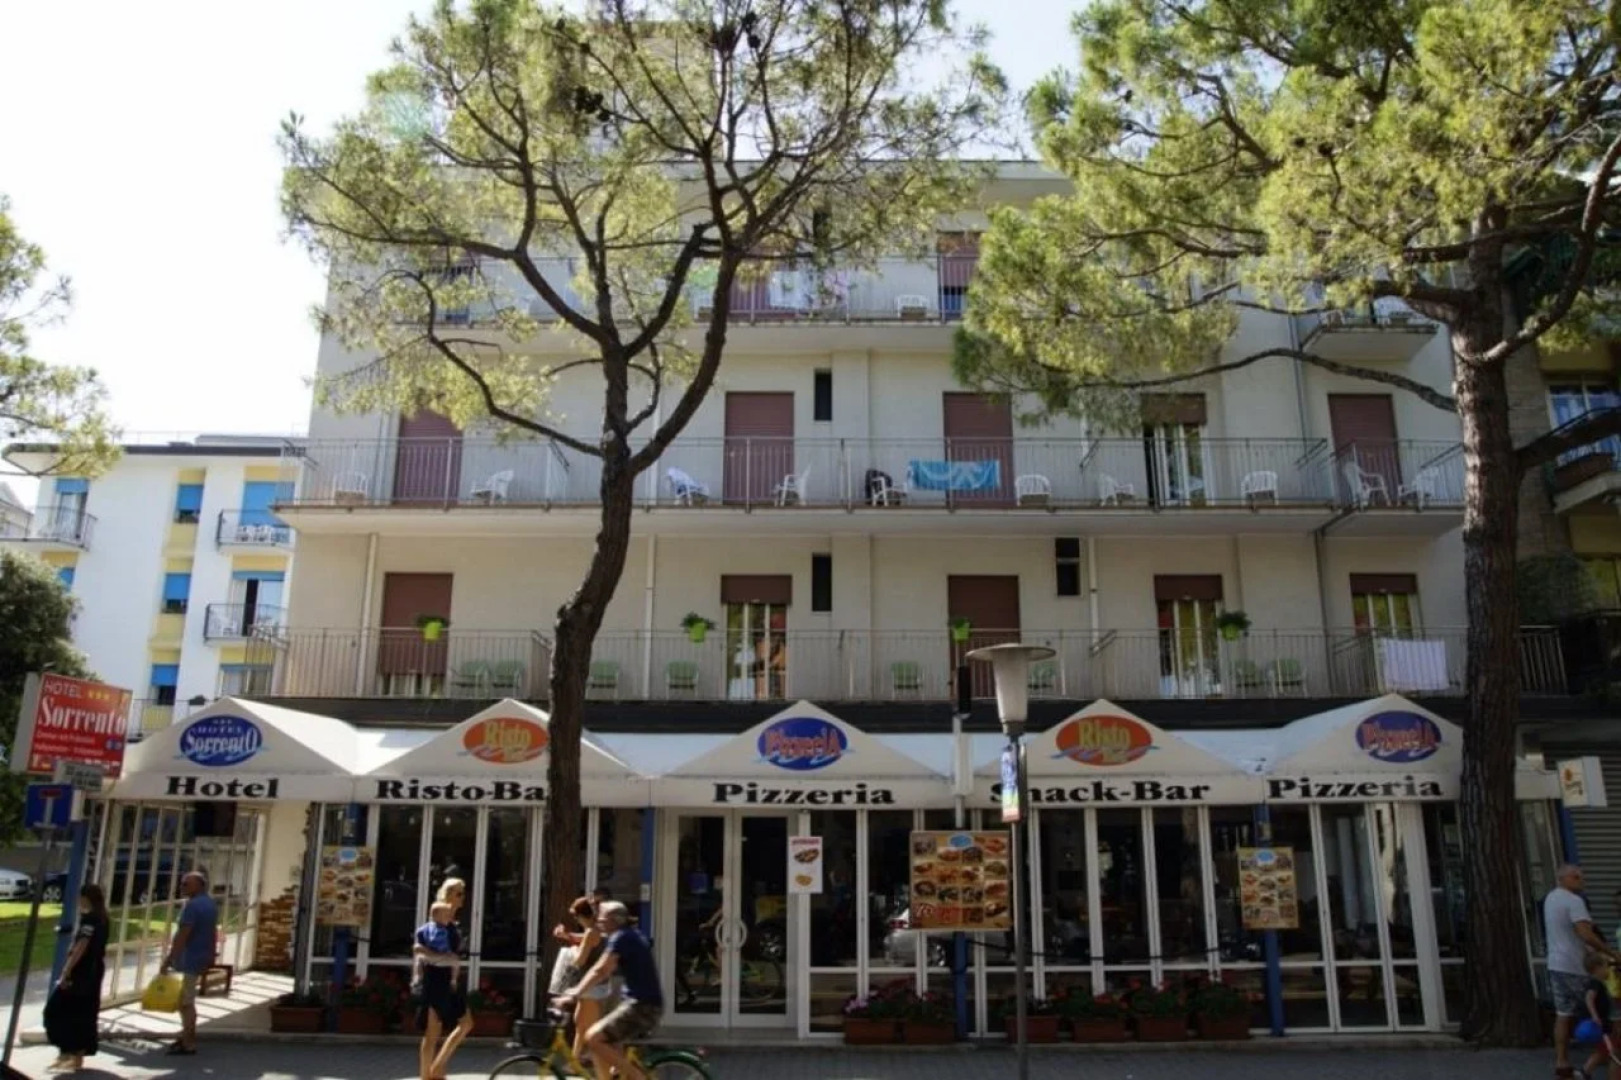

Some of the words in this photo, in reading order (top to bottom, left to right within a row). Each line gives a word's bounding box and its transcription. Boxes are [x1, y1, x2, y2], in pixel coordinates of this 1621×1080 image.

[44, 681, 82, 699] HOTEL
[38, 695, 127, 734] Sorrento
[167, 776, 279, 799] Hotel
[376, 779, 550, 802] Risto-Ba
[713, 781, 895, 805] Pizzeria
[1266, 775, 1444, 800] Pizzeria
